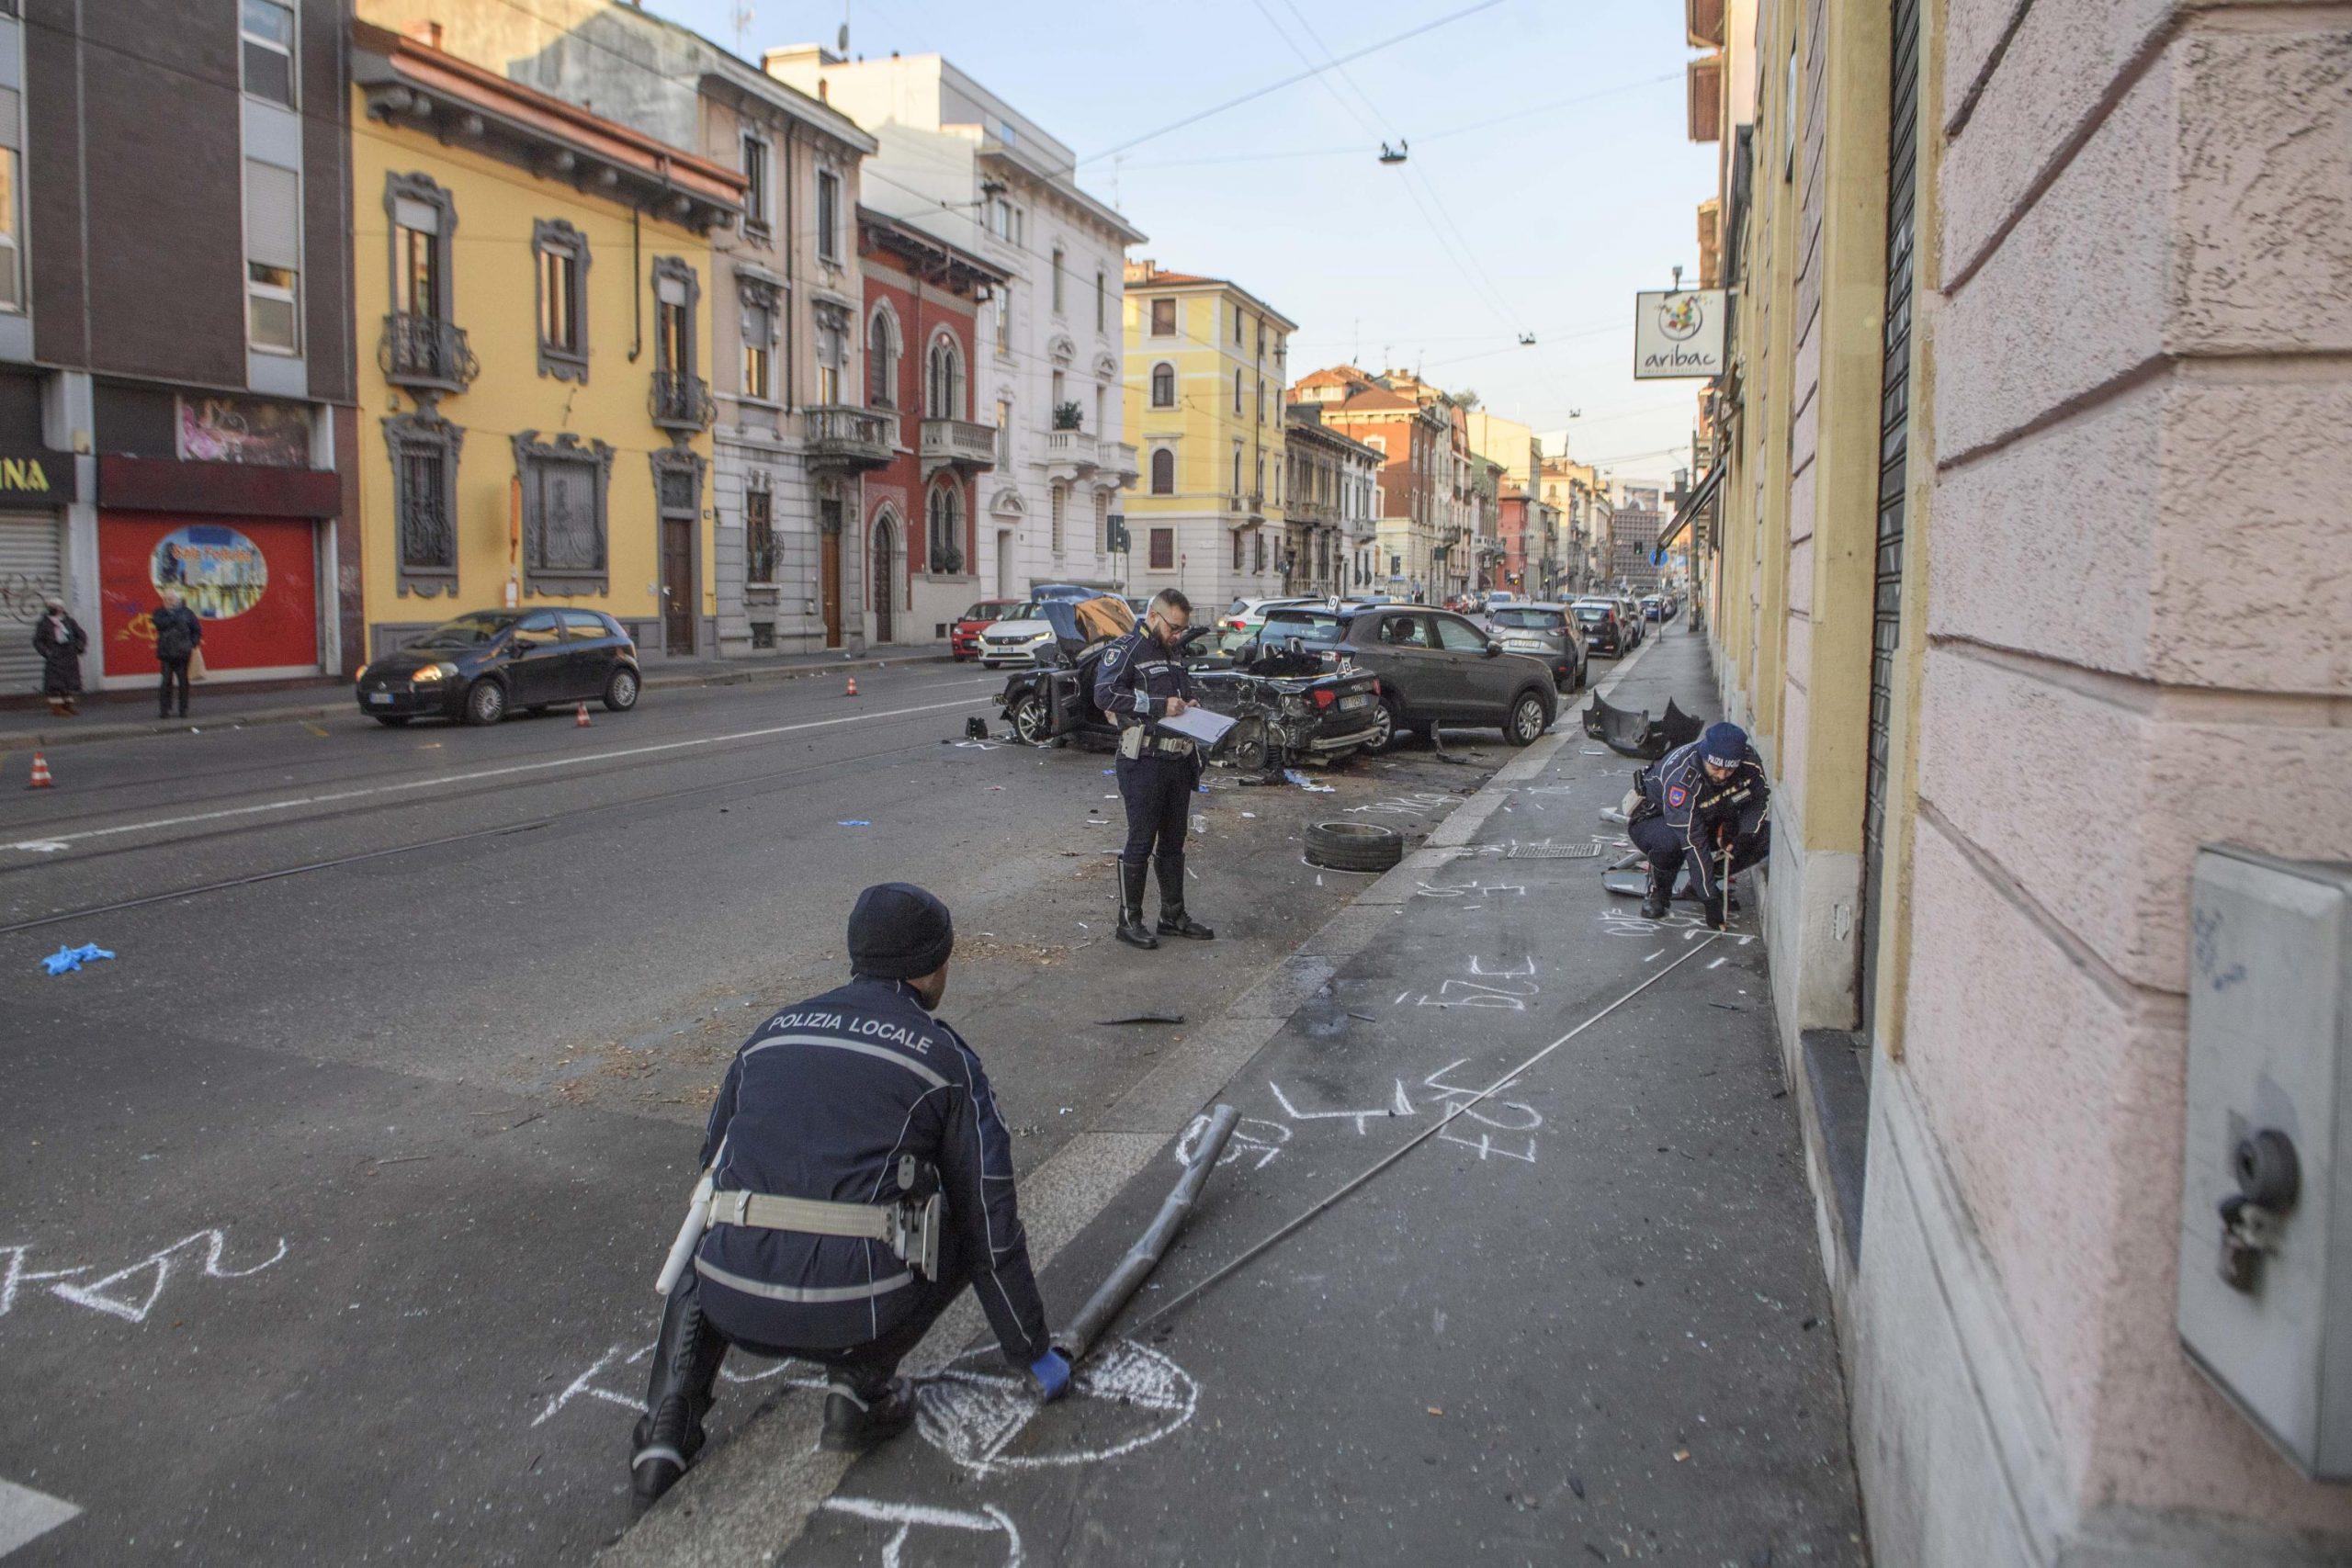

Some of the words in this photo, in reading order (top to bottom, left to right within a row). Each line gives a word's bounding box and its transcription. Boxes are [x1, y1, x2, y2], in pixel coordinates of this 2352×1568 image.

[1645, 344, 1716, 367] aribac
[1329, 597, 1337, 607] D
[1343, 661, 1351, 673] B
[768, 1012, 842, 1032] POLIZIA
[849, 1017, 933, 1055] LOCALE
